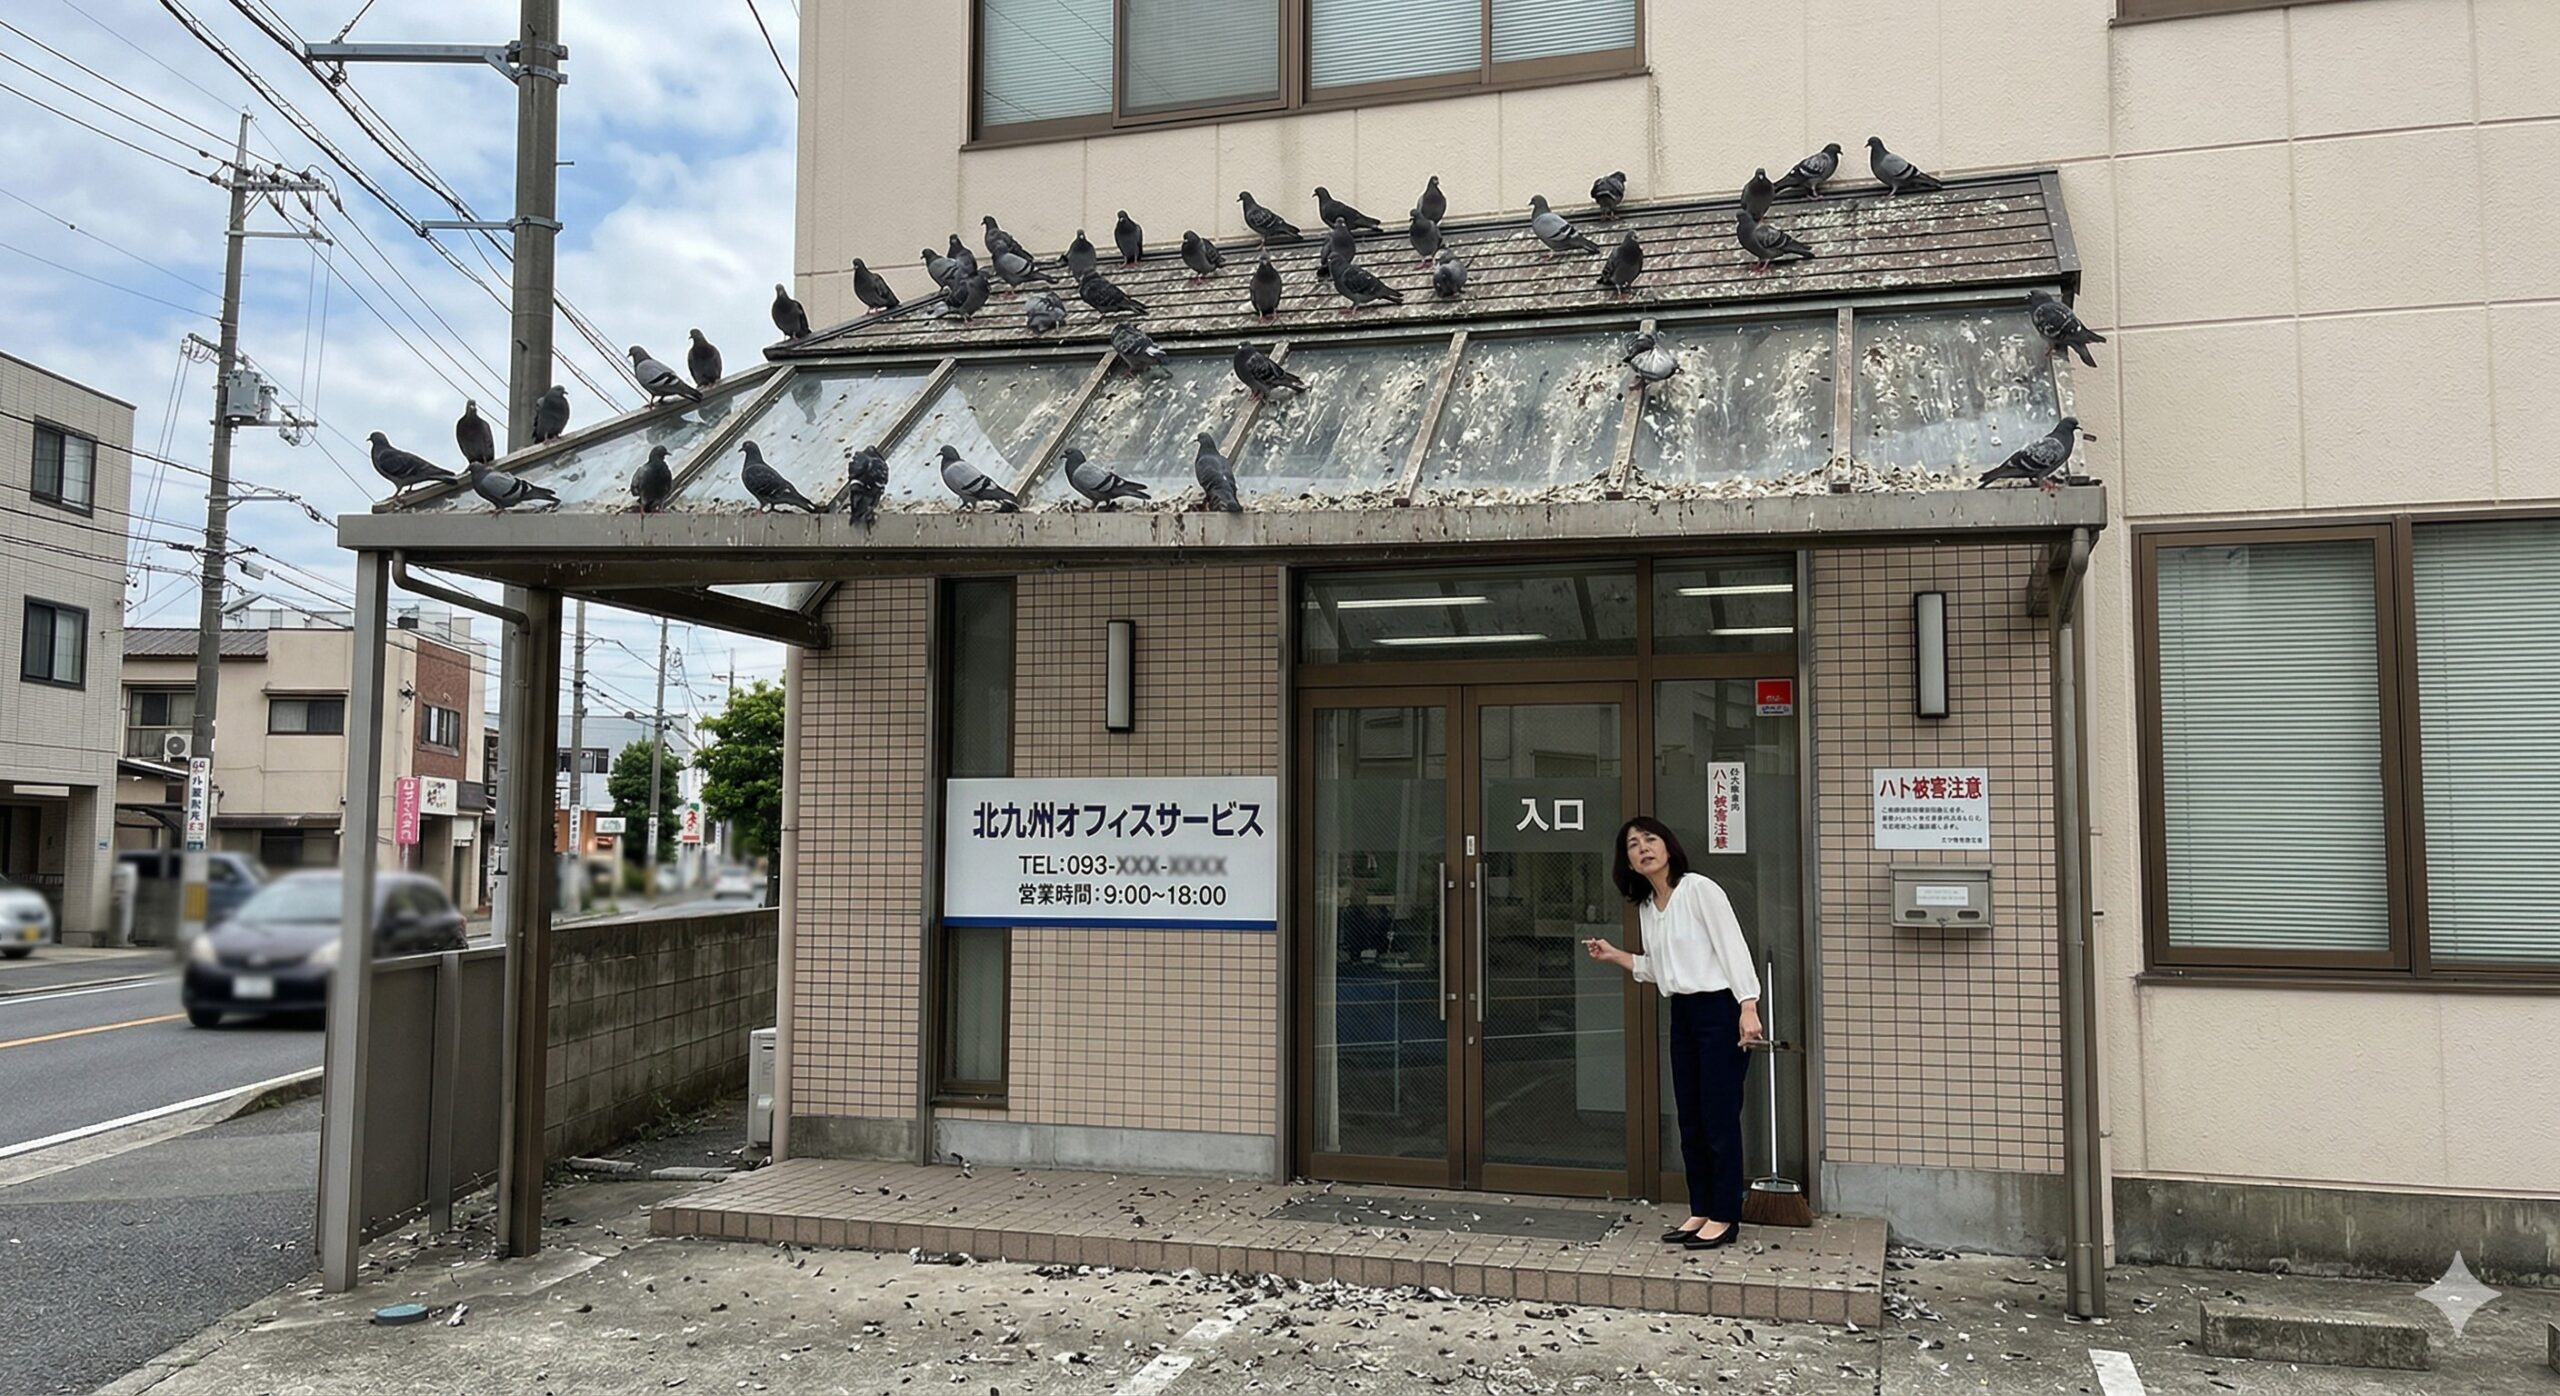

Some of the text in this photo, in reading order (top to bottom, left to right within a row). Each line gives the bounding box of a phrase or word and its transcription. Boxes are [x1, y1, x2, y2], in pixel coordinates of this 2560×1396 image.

[1880, 776, 1982, 799] ハト被害注意
[972, 801, 1265, 839] 北九州オフィスサービス
[1516, 798, 1584, 832] 入口
